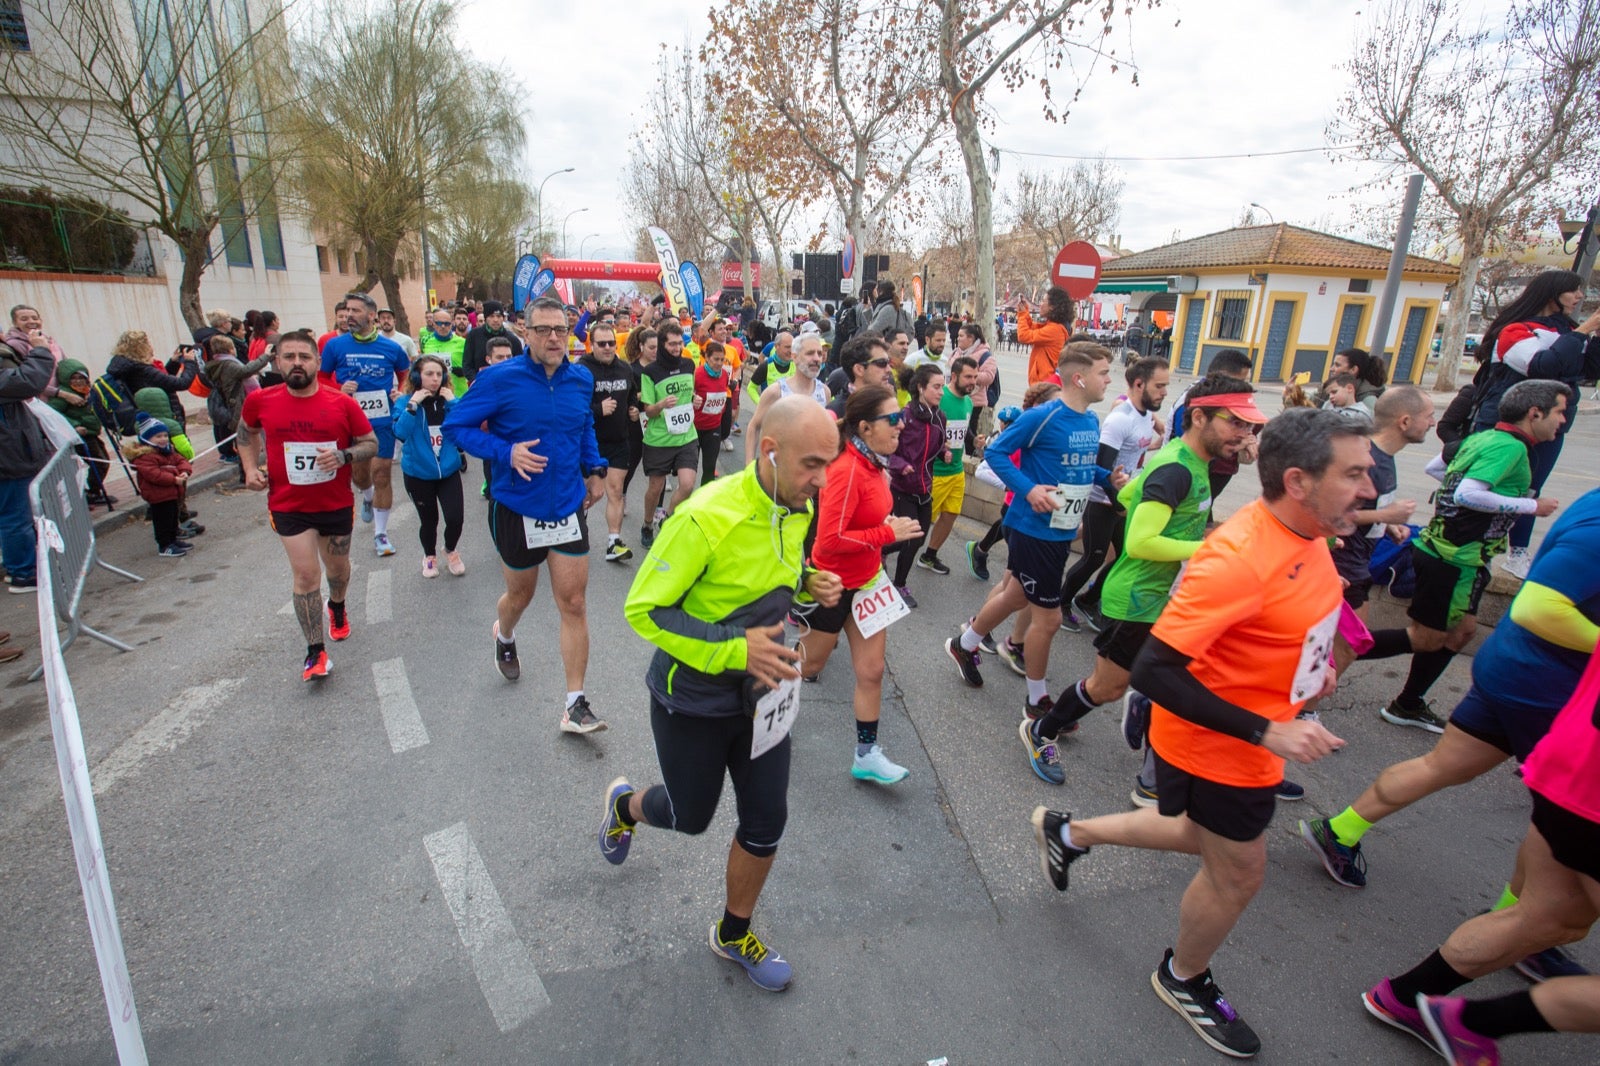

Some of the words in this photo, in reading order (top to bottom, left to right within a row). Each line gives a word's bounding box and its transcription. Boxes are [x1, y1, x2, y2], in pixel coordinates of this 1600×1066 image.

[361, 399, 383, 410] 223
[671, 412, 691, 425] 560
[1069, 435, 1098, 443] MARATO
[1061, 453, 1080, 466] 18
[855, 585, 895, 621] 2017
